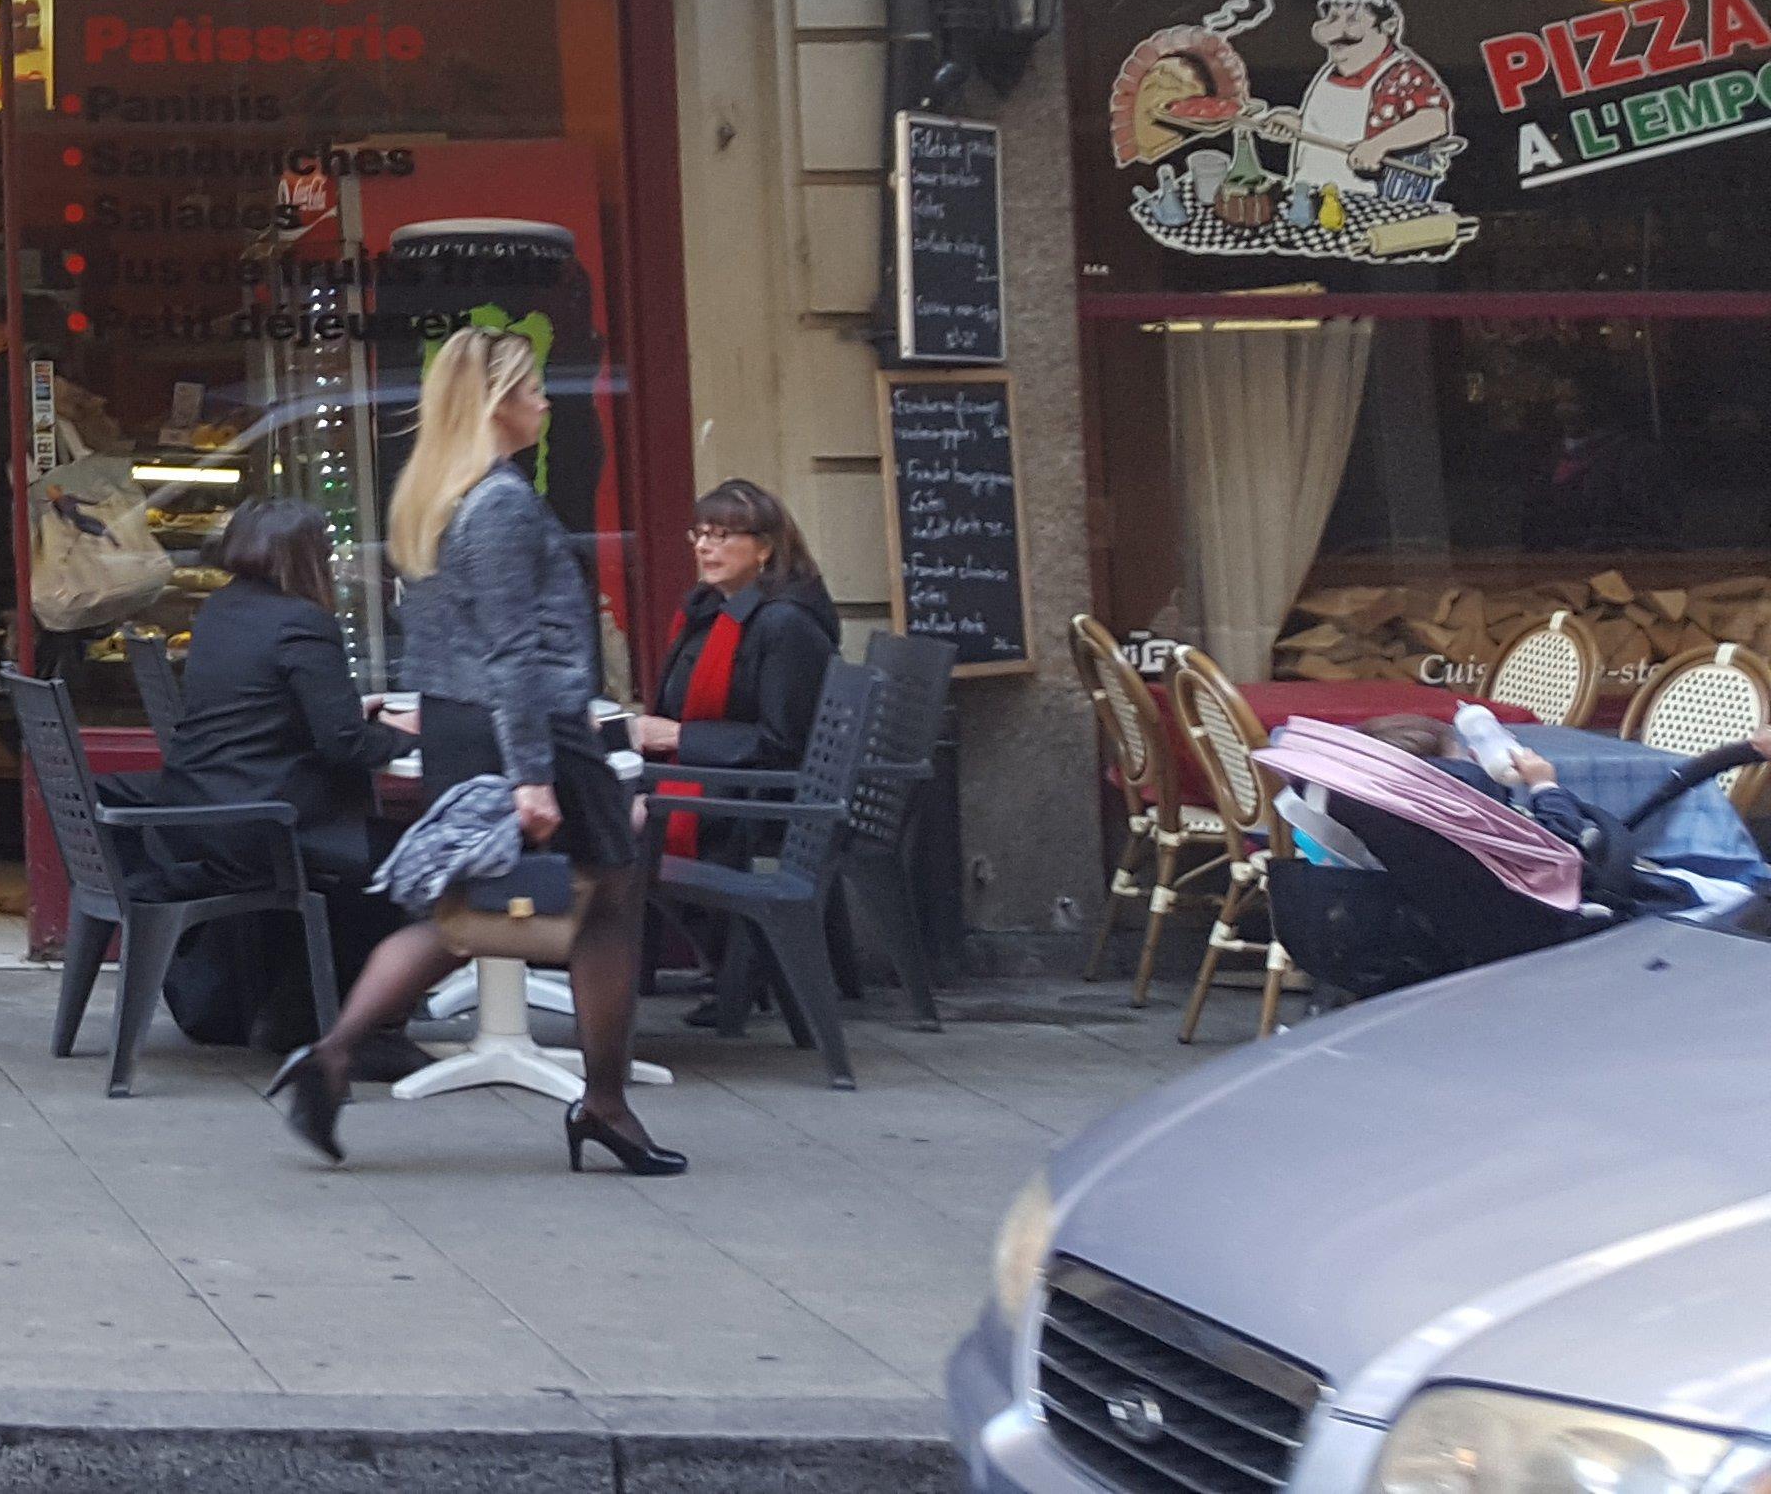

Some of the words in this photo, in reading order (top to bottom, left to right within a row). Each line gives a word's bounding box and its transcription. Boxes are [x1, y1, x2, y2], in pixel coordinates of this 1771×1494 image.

[85, 14, 426, 64] Patisserie
[86, 84, 285, 125] Paninis
[1518, 122, 1563, 175] A
[1570, 61, 1771, 160] L'EMP
[91, 138, 416, 178] Sandwiches
[92, 192, 301, 233] Salades
